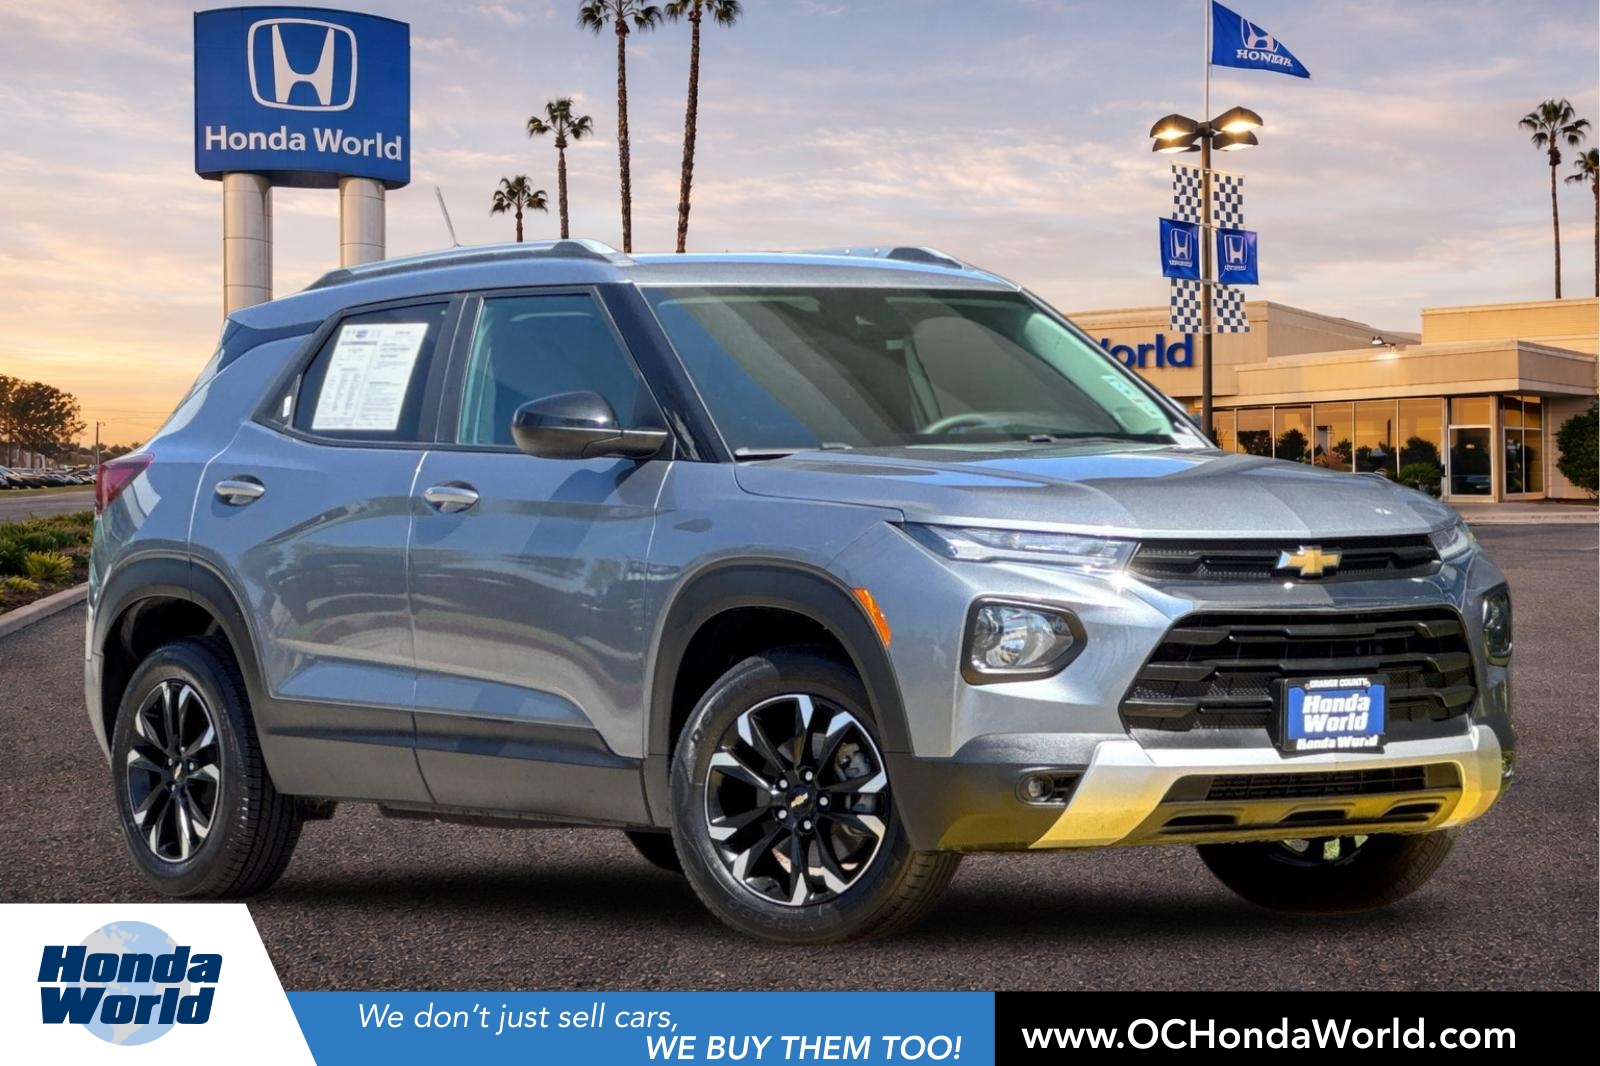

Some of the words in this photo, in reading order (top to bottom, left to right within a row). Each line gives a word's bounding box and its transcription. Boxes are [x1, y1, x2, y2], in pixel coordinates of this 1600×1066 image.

[205, 125, 306, 151] Honda
[313, 127, 402, 160] World
[1302, 693, 1371, 714] Honda
[1304, 711, 1368, 733] World
[1296, 737, 1336, 750] Honda
[1337, 734, 1379, 748] World
